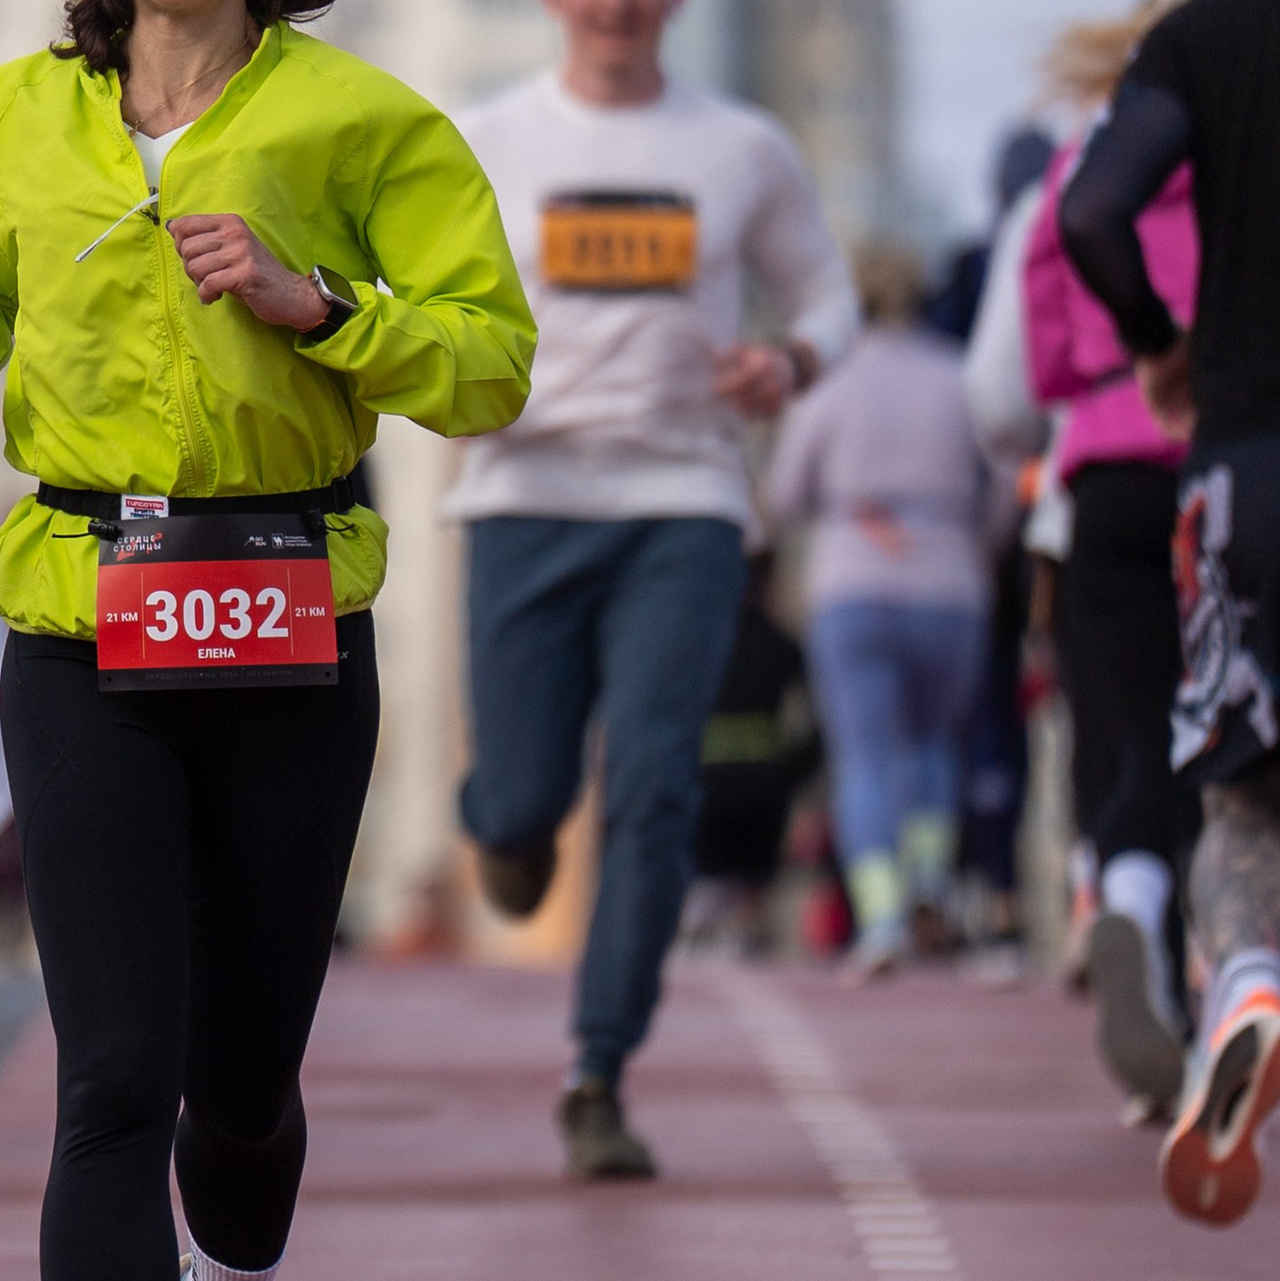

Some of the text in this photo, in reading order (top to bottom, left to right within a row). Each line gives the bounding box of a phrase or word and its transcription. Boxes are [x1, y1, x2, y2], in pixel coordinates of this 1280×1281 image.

[117, 534, 156, 545] СЕРДЦЕ
[113, 542, 162, 553] СТОЛИЦЫ
[106, 613, 118, 623] 21
[145, 587, 289, 642] 3032
[295, 608, 306, 618] 21
[198, 648, 236, 659] ЕЛЕНА
